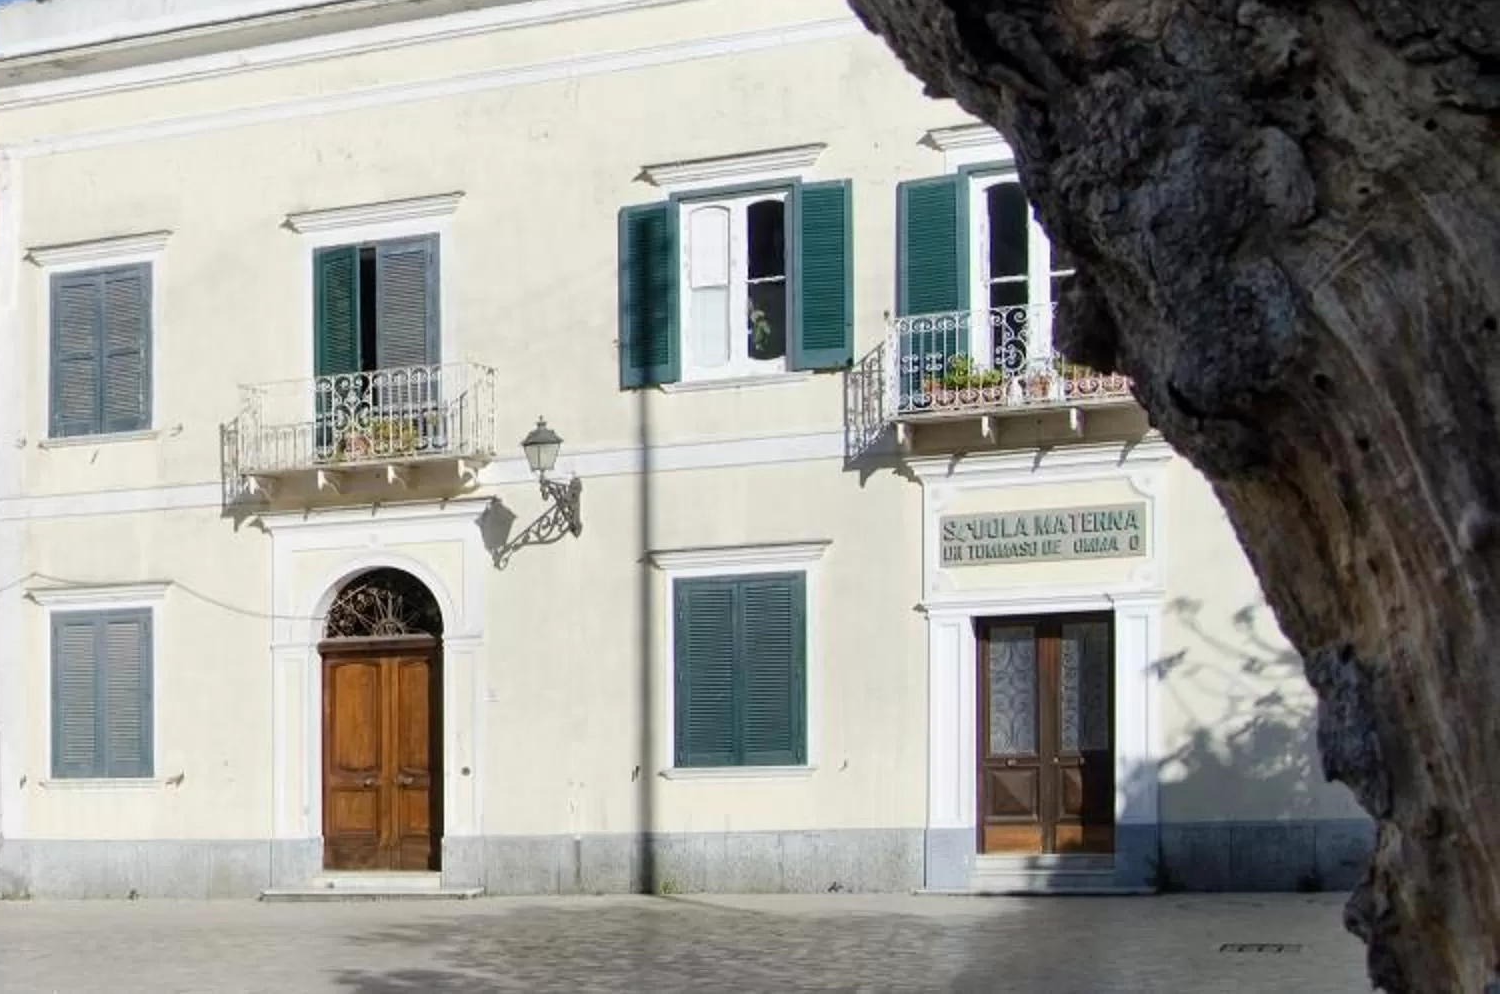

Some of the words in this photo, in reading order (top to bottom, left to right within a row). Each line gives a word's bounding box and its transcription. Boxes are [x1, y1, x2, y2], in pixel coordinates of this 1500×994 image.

[943, 514, 1029, 543] SCUOLA
[1034, 510, 1139, 536] MATERNA
[1041, 539, 1062, 556] DE
